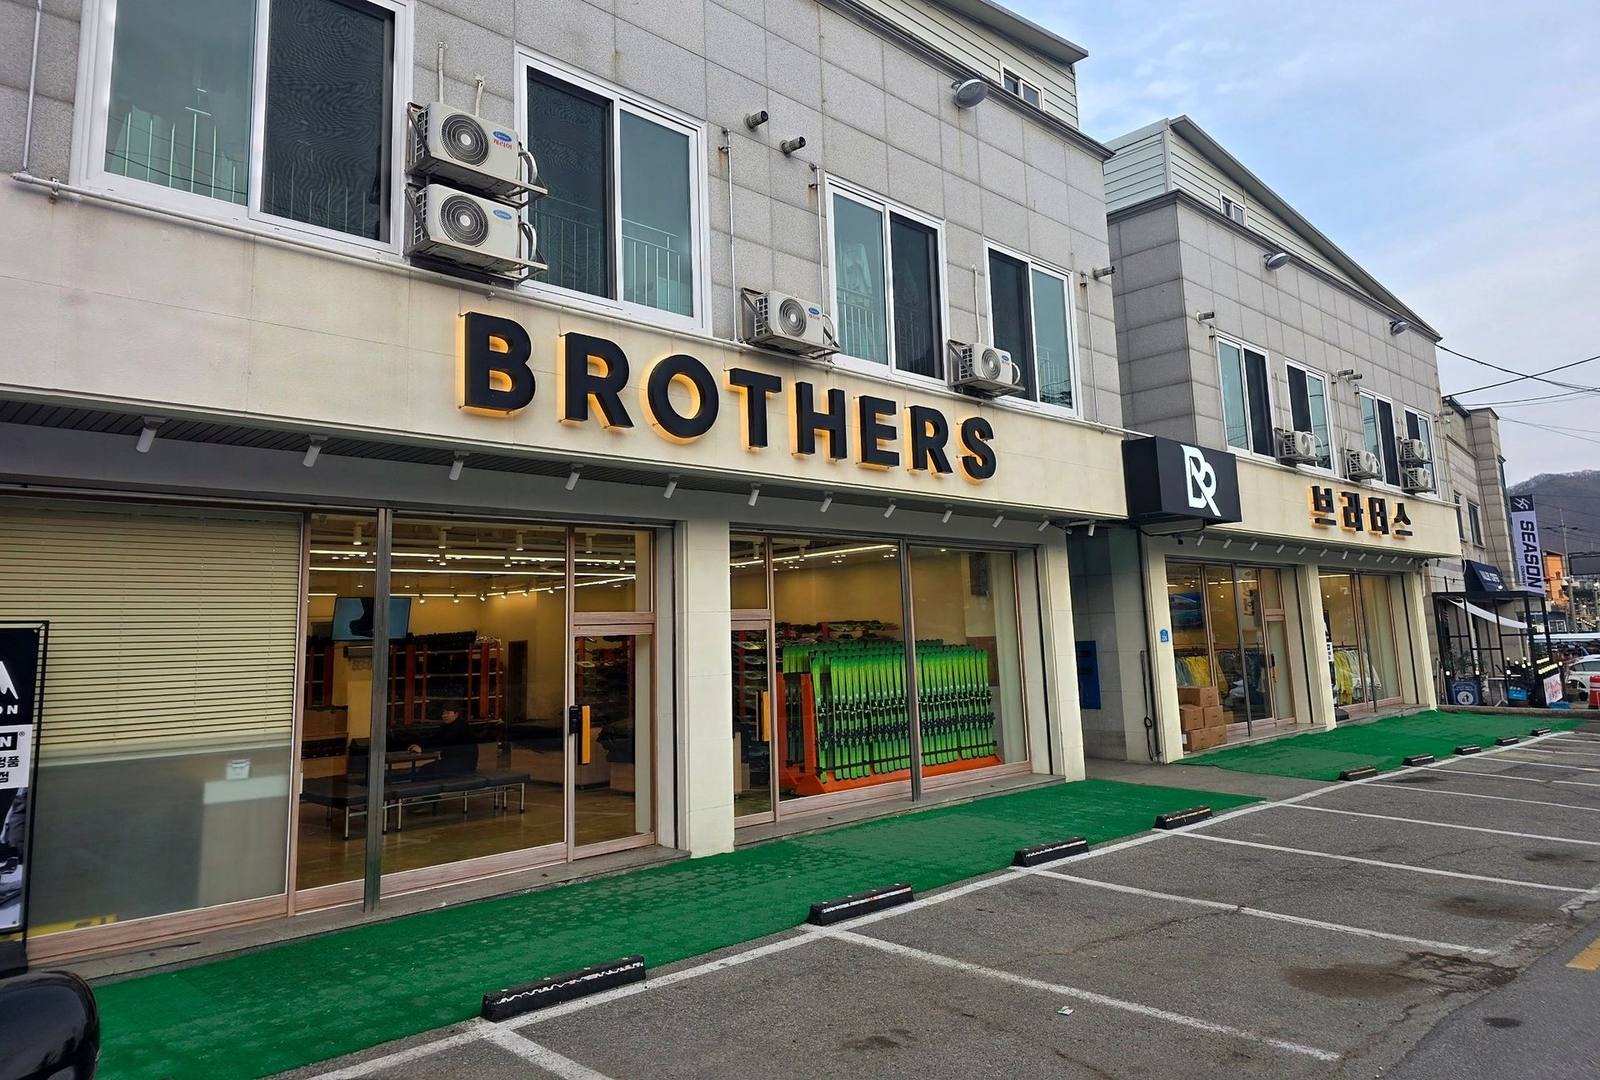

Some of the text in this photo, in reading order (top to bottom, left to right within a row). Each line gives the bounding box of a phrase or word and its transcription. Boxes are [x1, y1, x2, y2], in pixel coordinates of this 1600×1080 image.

[462, 311, 997, 481] BROTHERS
[1310, 485, 1414, 536] 브라더스
[1520, 520, 1542, 589] SEASON
